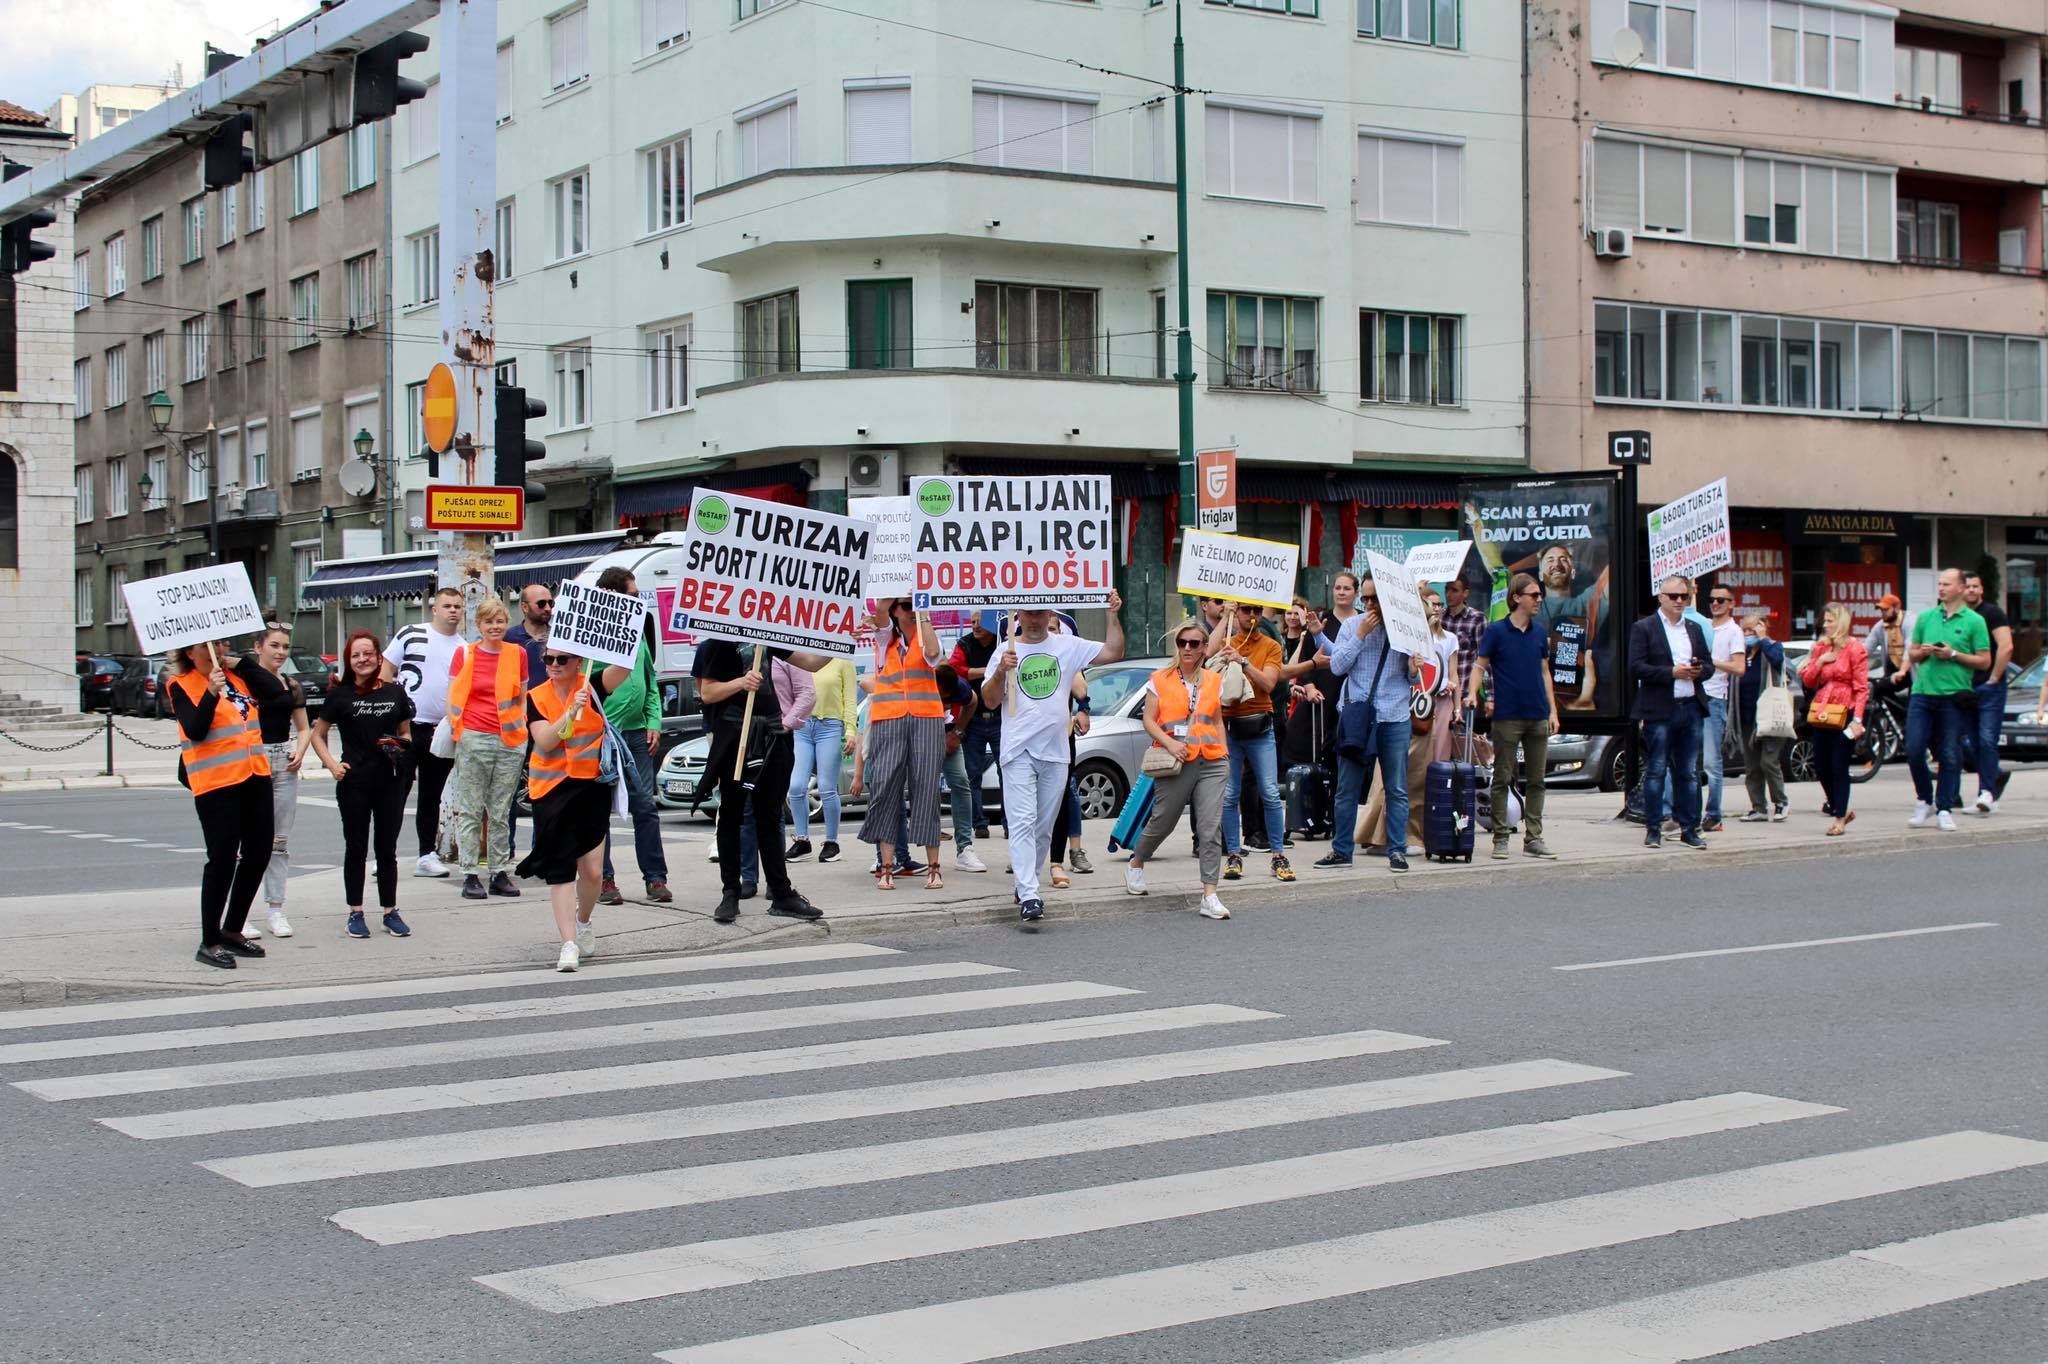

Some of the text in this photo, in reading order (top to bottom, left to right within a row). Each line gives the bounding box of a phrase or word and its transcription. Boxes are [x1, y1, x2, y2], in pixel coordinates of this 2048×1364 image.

[444, 497, 505, 507] PJEŠACI OPREZ!
[920, 494, 952, 502] ReSTART
[958, 480, 1110, 514] ITALIJANI,
[1662, 486, 1723, 524] 66000 TURISTA
[437, 509, 512, 519] POŠTUJTE SIGNALE!
[697, 509, 728, 522] ReSTART
[1202, 508, 1234, 527] triglav
[1480, 504, 1592, 520] SCAN & PARTY
[1804, 515, 1895, 530] AVANGARDIA
[733, 506, 870, 560] TURIZAM
[874, 533, 898, 544] KORDE
[917, 520, 1108, 556] ARAPI, IRCI
[1369, 534, 1404, 549] LATTES
[1480, 525, 1593, 542] DAVID GUETTA
[1715, 532, 1727, 548] KM
[870, 553, 896, 564] RIZAM
[1190, 544, 1289, 574] NE ŽELIMO POMOĆ,
[1651, 537, 1683, 561] 158.000
[686, 540, 862, 599] SPORT I KULTURA
[916, 551, 1109, 590] DOBRODOŠLI
[1695, 551, 1728, 573] TURIZMA
[1197, 565, 1278, 593] ŽELIMO POSAO!
[157, 578, 230, 607] STOP DALJNJEM
[562, 583, 643, 615] NO TOURISTS
[936, 596, 987, 605] KONKRETNO,
[988, 595, 1056, 604] TRANSPARENTNO
[1061, 595, 1108, 603] DOSLJEDNO
[1830, 582, 1892, 600] TOTALNA
[568, 599, 632, 627] NO MONEY
[679, 577, 856, 635] BEZ GRANICA
[146, 604, 257, 640] UNIŠTAVANJU TURIZMA!
[555, 610, 638, 643] NO BUSINESS
[553, 624, 635, 657] NO ECONOMY
[694, 620, 741, 636] KONKRETNO,
[742, 628, 804, 645] TRANSPARENTNO
[808, 639, 850, 653] DOSLJEDNO
[1021, 668, 1057, 682] ReSTART
[1553, 674, 1576, 684] OPEN
[352, 700, 372, 708] When
[373, 706, 392, 717] right
